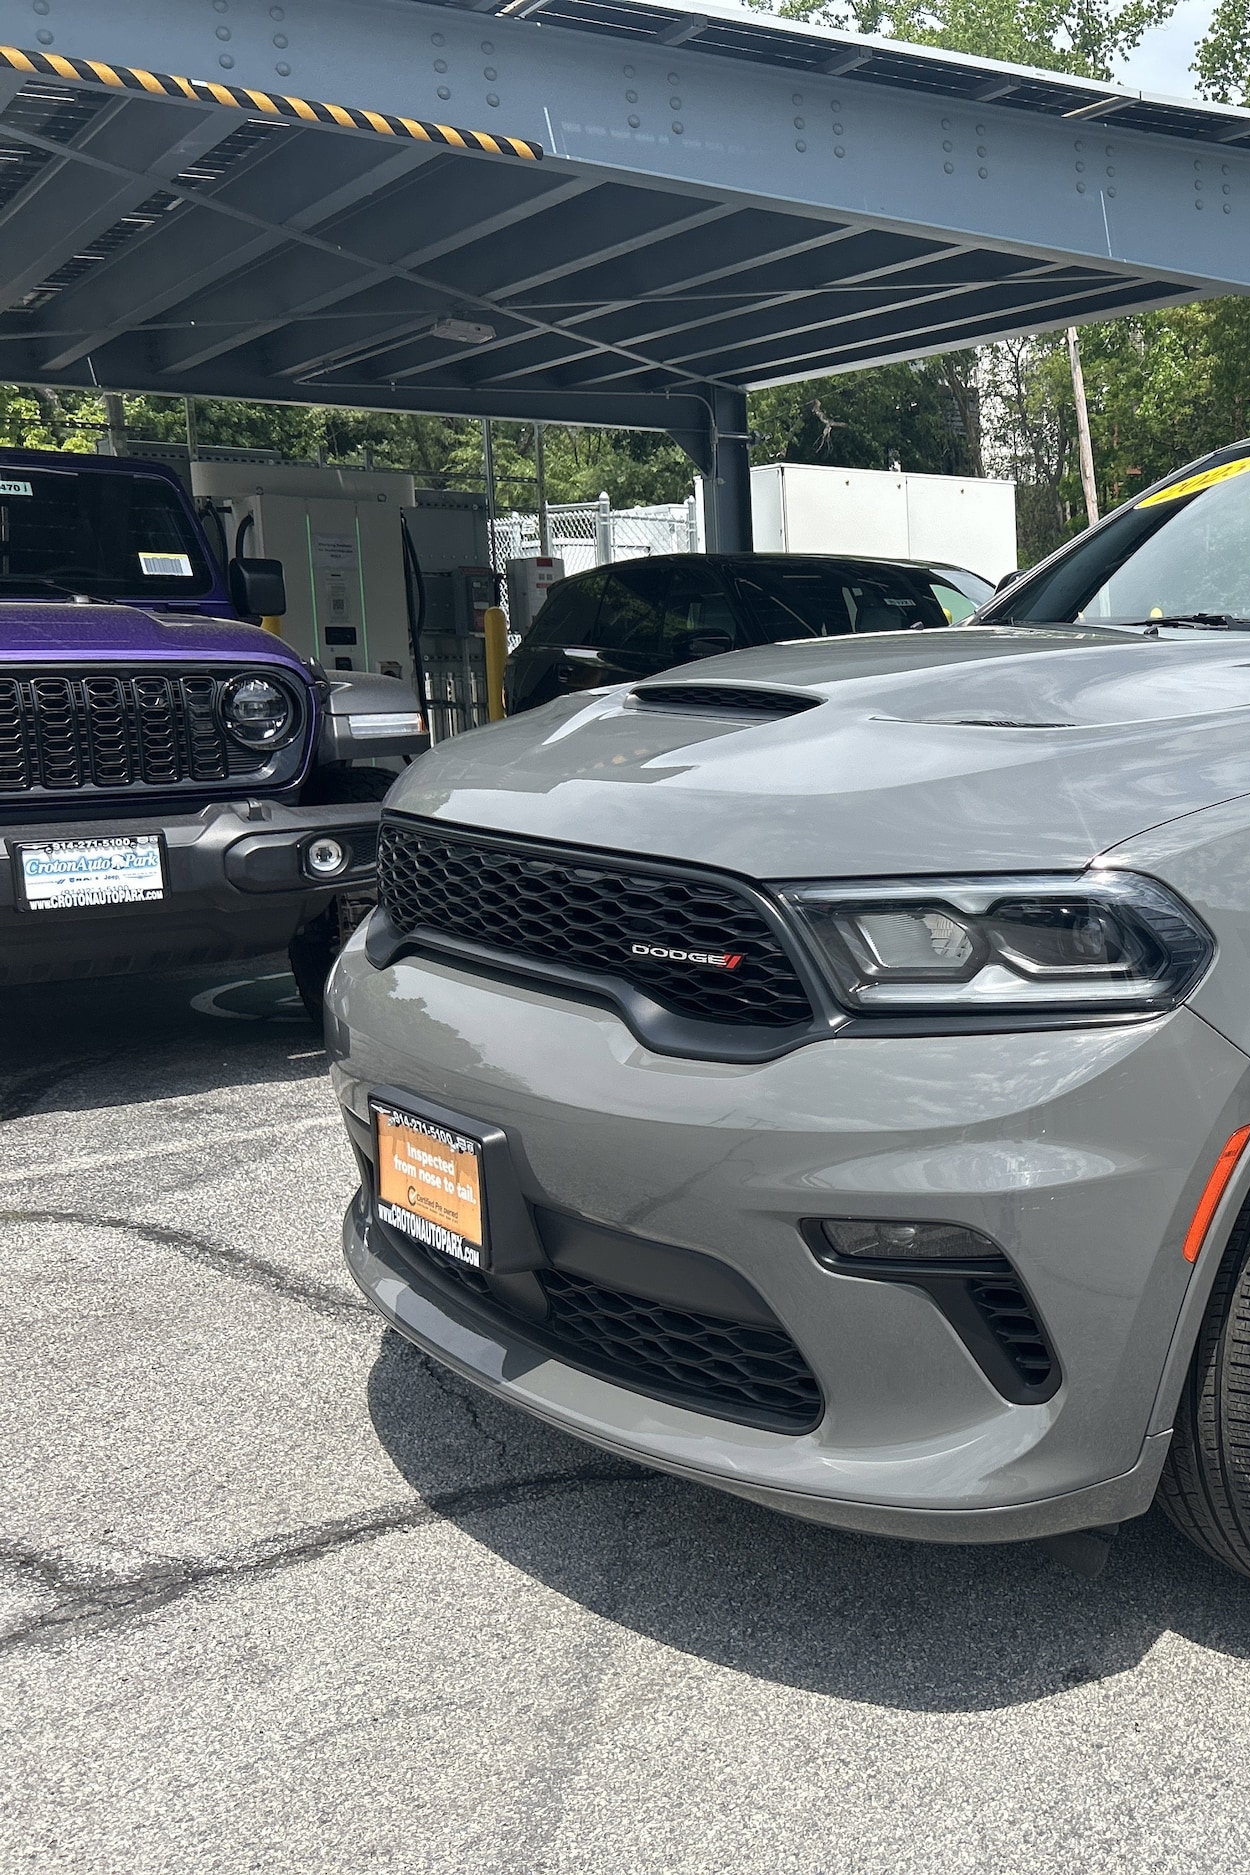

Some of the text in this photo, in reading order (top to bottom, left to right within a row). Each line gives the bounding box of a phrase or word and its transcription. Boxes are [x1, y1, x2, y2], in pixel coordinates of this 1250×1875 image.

[53, 838, 131, 850] 914-271-5100
[125, 851, 158, 868] Park
[632, 944, 727, 965] DODGE
[393, 1111, 453, 1145] 914-271-5100
[406, 1141, 455, 1176] Inspected
[394, 1154, 477, 1205] from nose to tail.
[416, 1194, 435, 1208] Certified
